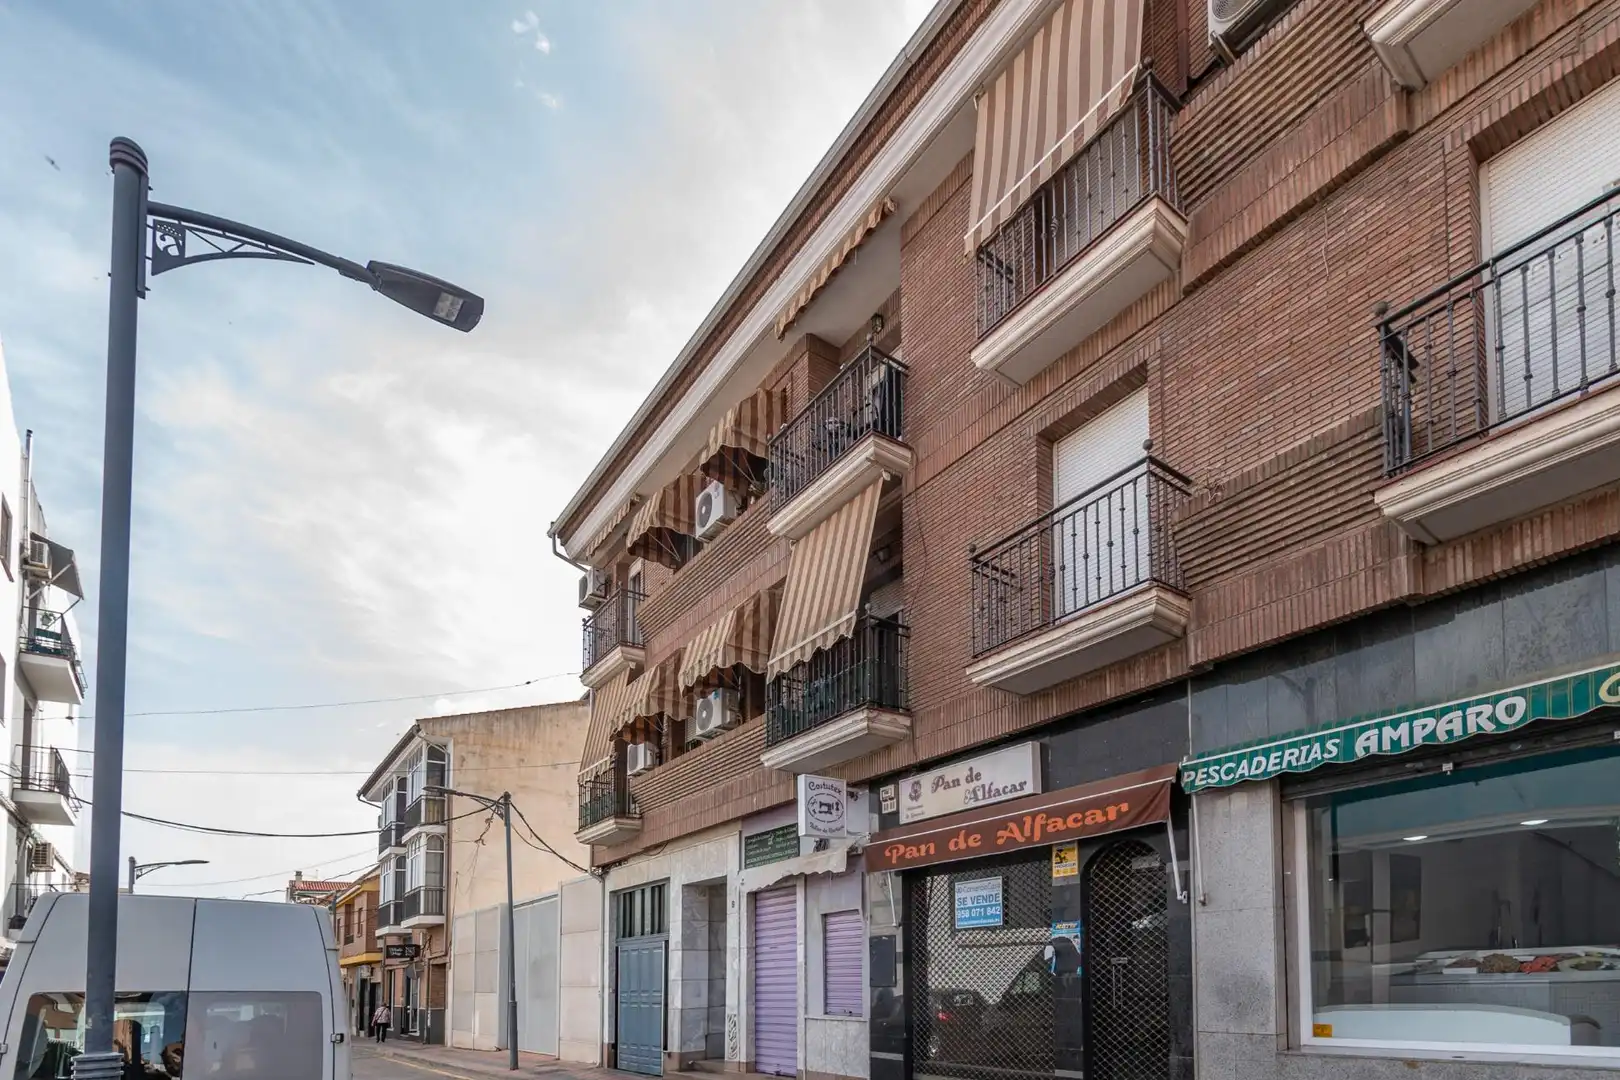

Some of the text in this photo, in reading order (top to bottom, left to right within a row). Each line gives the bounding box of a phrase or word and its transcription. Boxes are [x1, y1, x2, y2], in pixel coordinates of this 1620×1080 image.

[1181, 696, 1527, 787] PESCADERIAS AMPARO
[931, 767, 982, 794] Pan de
[963, 780, 1027, 805] Alfacar
[885, 802, 1129, 864] Pan de Alfacar
[957, 892, 1000, 907] SE VENDE
[971, 907, 985, 917] 071
[986, 906, 1001, 916] 842
